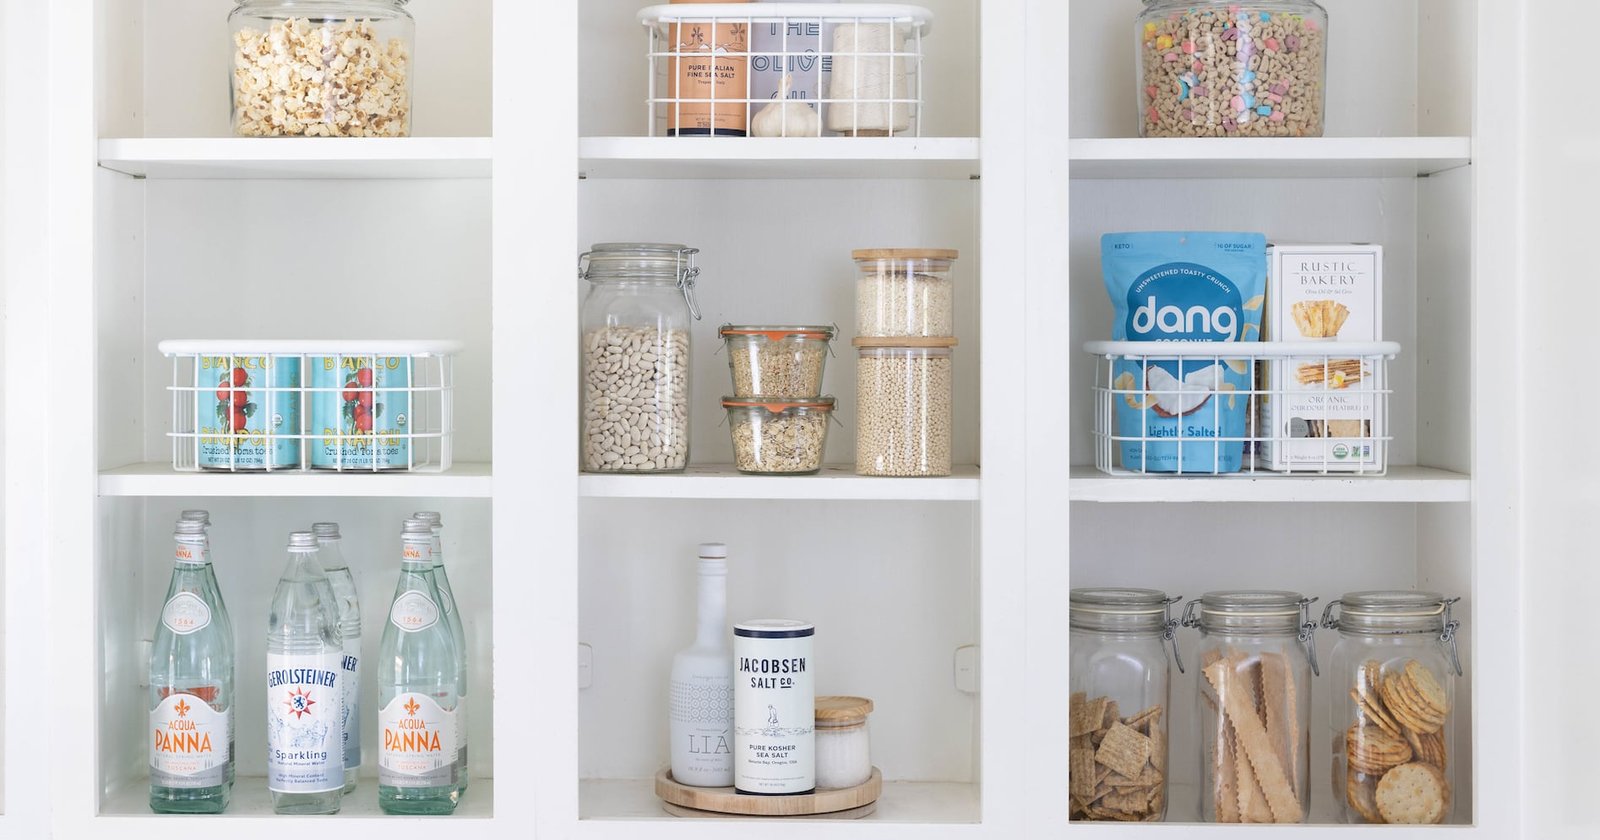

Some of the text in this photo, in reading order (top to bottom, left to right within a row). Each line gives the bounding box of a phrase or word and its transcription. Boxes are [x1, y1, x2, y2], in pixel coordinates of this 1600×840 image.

[751, 49, 833, 72] OLIVE
[1301, 262, 1356, 272] RUSTIC
[1135, 268, 1231, 294] UNSWEETENED TOASTY CRUNCH
[1300, 275, 1357, 285] BAKERY
[1132, 295, 1238, 342] dang
[201, 356, 273, 370] BIANCO
[324, 356, 400, 370] BANCO
[233, 446, 273, 455] Tomatos
[325, 447, 357, 456] Cruhed
[740, 657, 806, 673] JACOBSEN
[268, 668, 336, 688] GEROLSTEINER
[751, 677, 795, 688] SALT CO.
[168, 720, 196, 730] ACQUA
[398, 719, 426, 729] ACQUA
[155, 728, 212, 753] PANNA
[385, 728, 441, 752] PANNA
[688, 729, 731, 754] LIÁ
[276, 750, 327, 761] Sparkling
